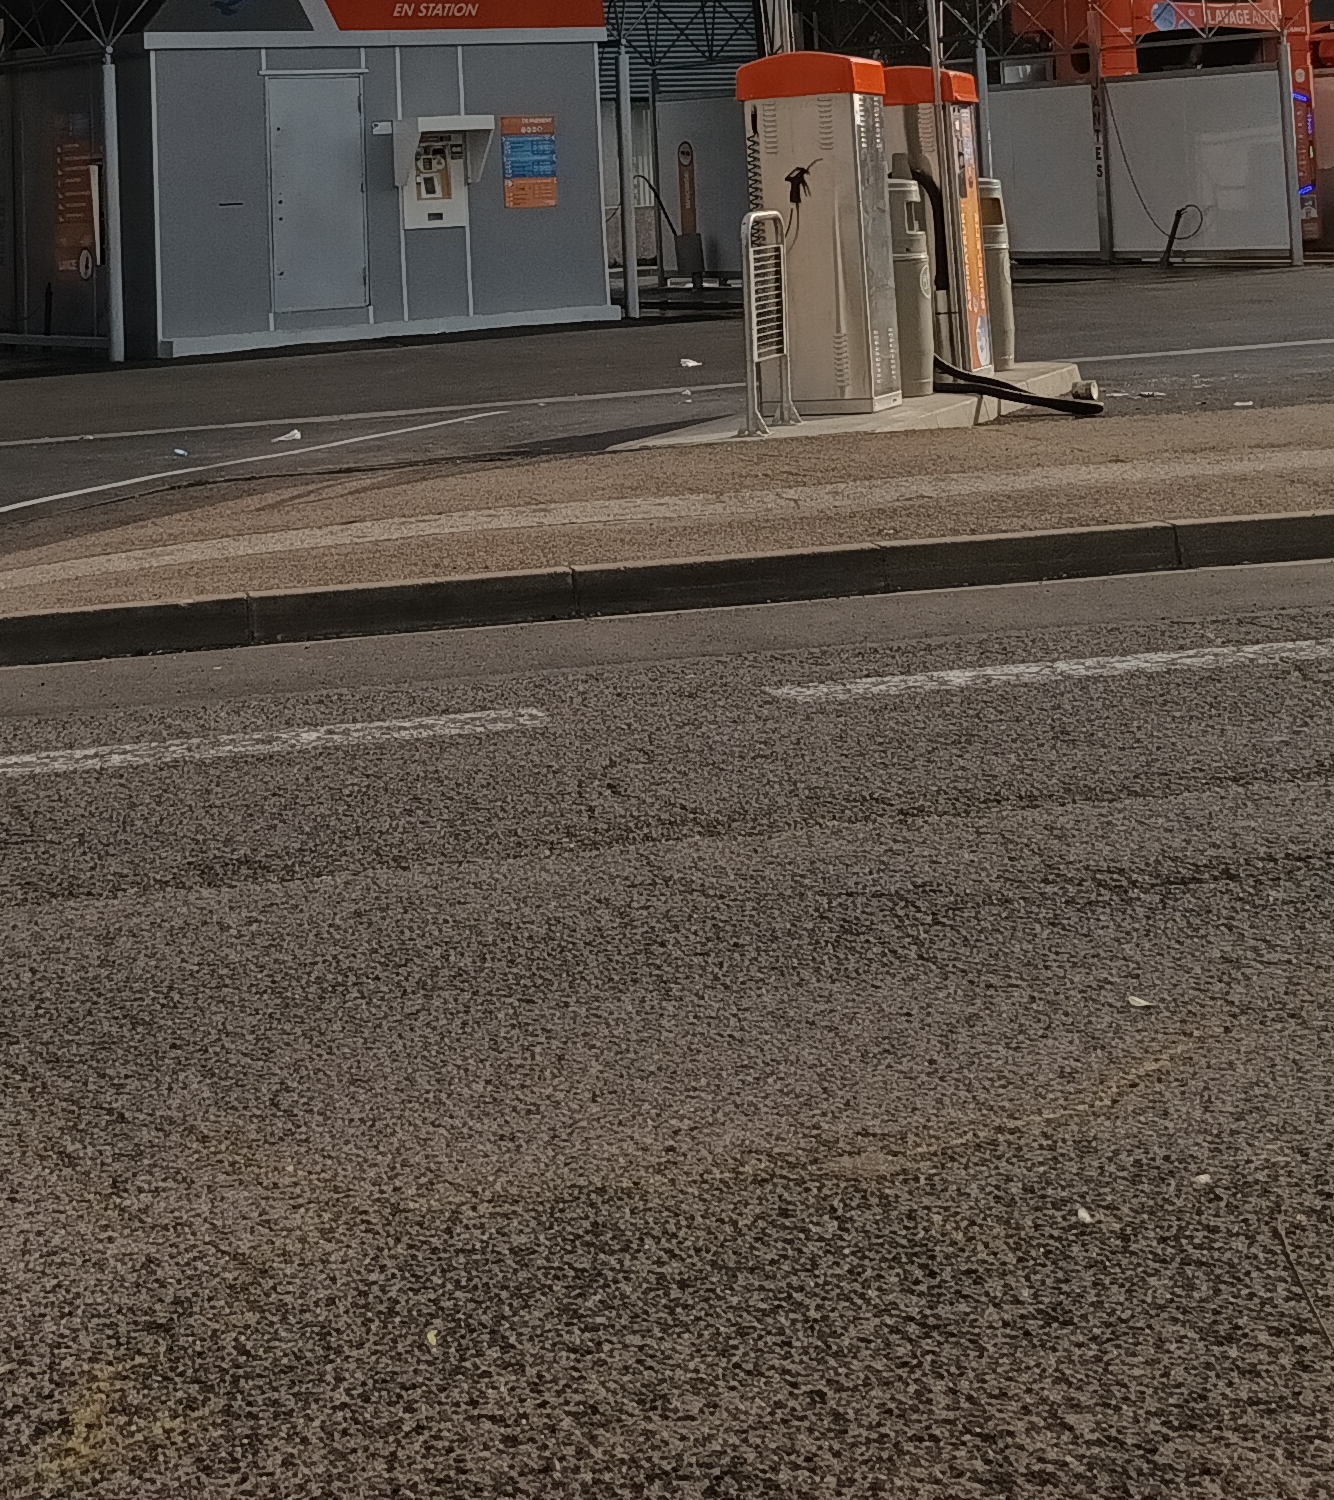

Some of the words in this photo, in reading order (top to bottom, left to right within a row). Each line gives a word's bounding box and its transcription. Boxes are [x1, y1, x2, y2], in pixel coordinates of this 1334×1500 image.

[393, 2, 414, 17] EN
[417, 2, 479, 18] STATION
[1207, 9, 1251, 25] LAVAGE
